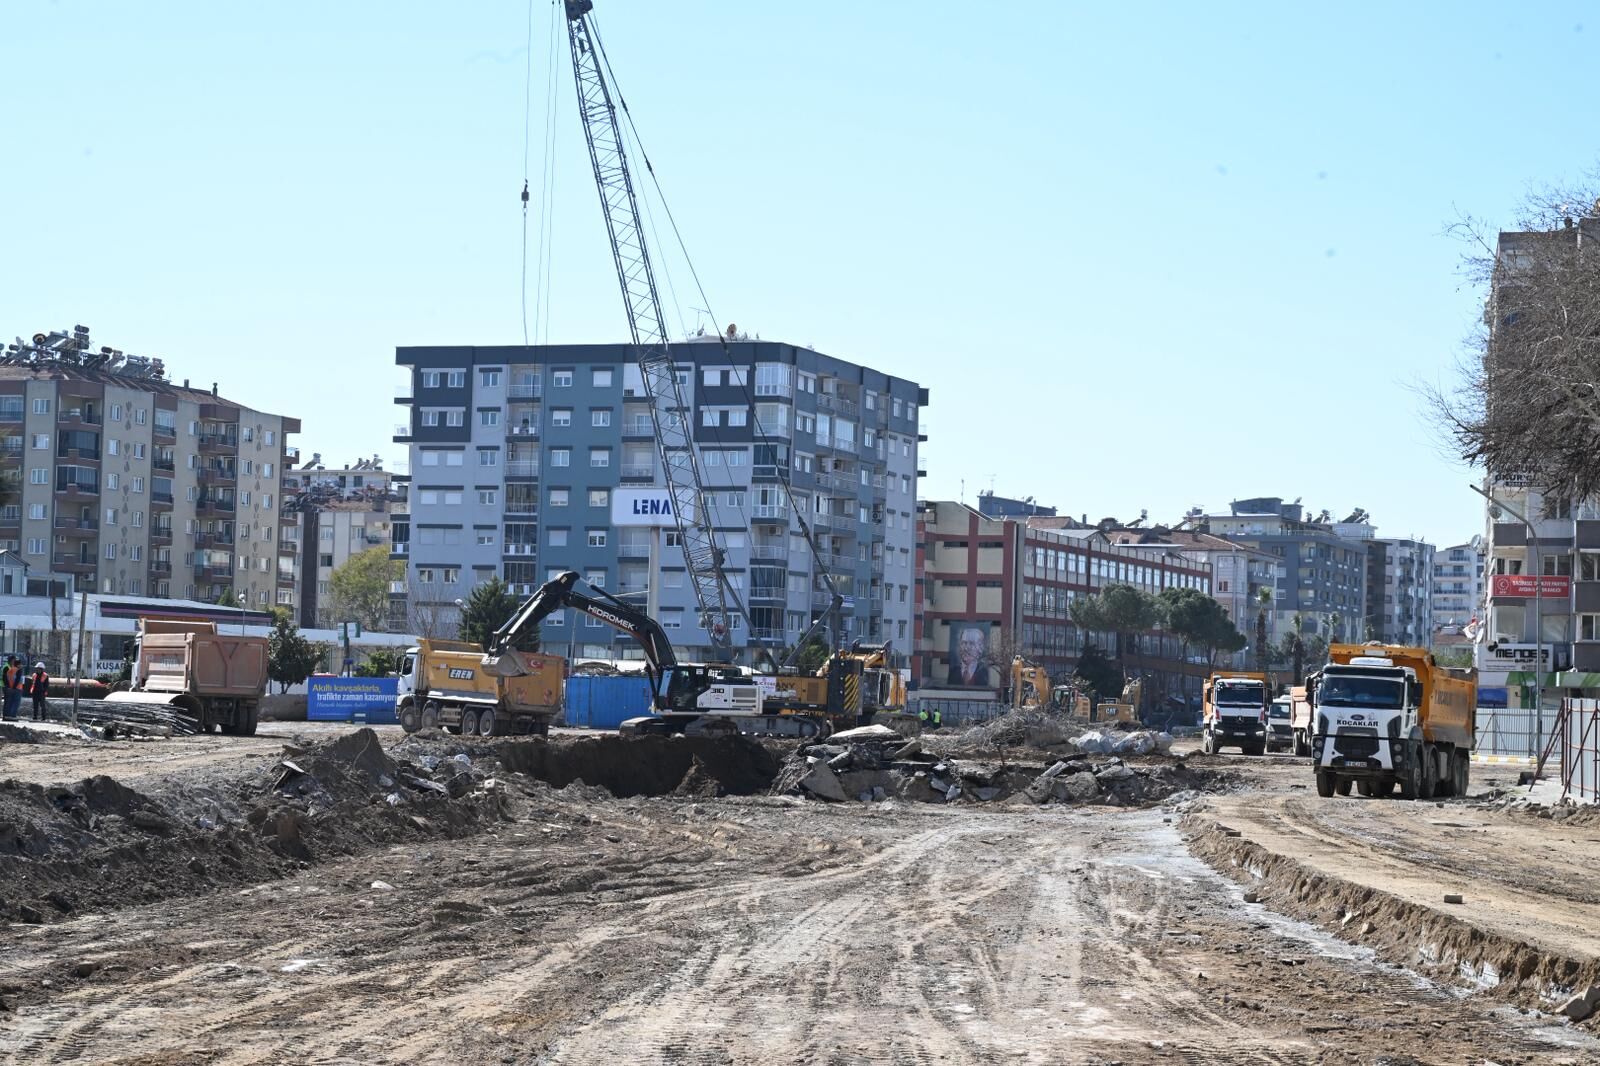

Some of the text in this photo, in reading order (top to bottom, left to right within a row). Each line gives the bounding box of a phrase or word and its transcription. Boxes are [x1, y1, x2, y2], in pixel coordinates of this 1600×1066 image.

[633, 499, 671, 514] LENA
[450, 669, 473, 679] EREN
[774, 682, 796, 691] ANY
[317, 692, 341, 701] trafikte
